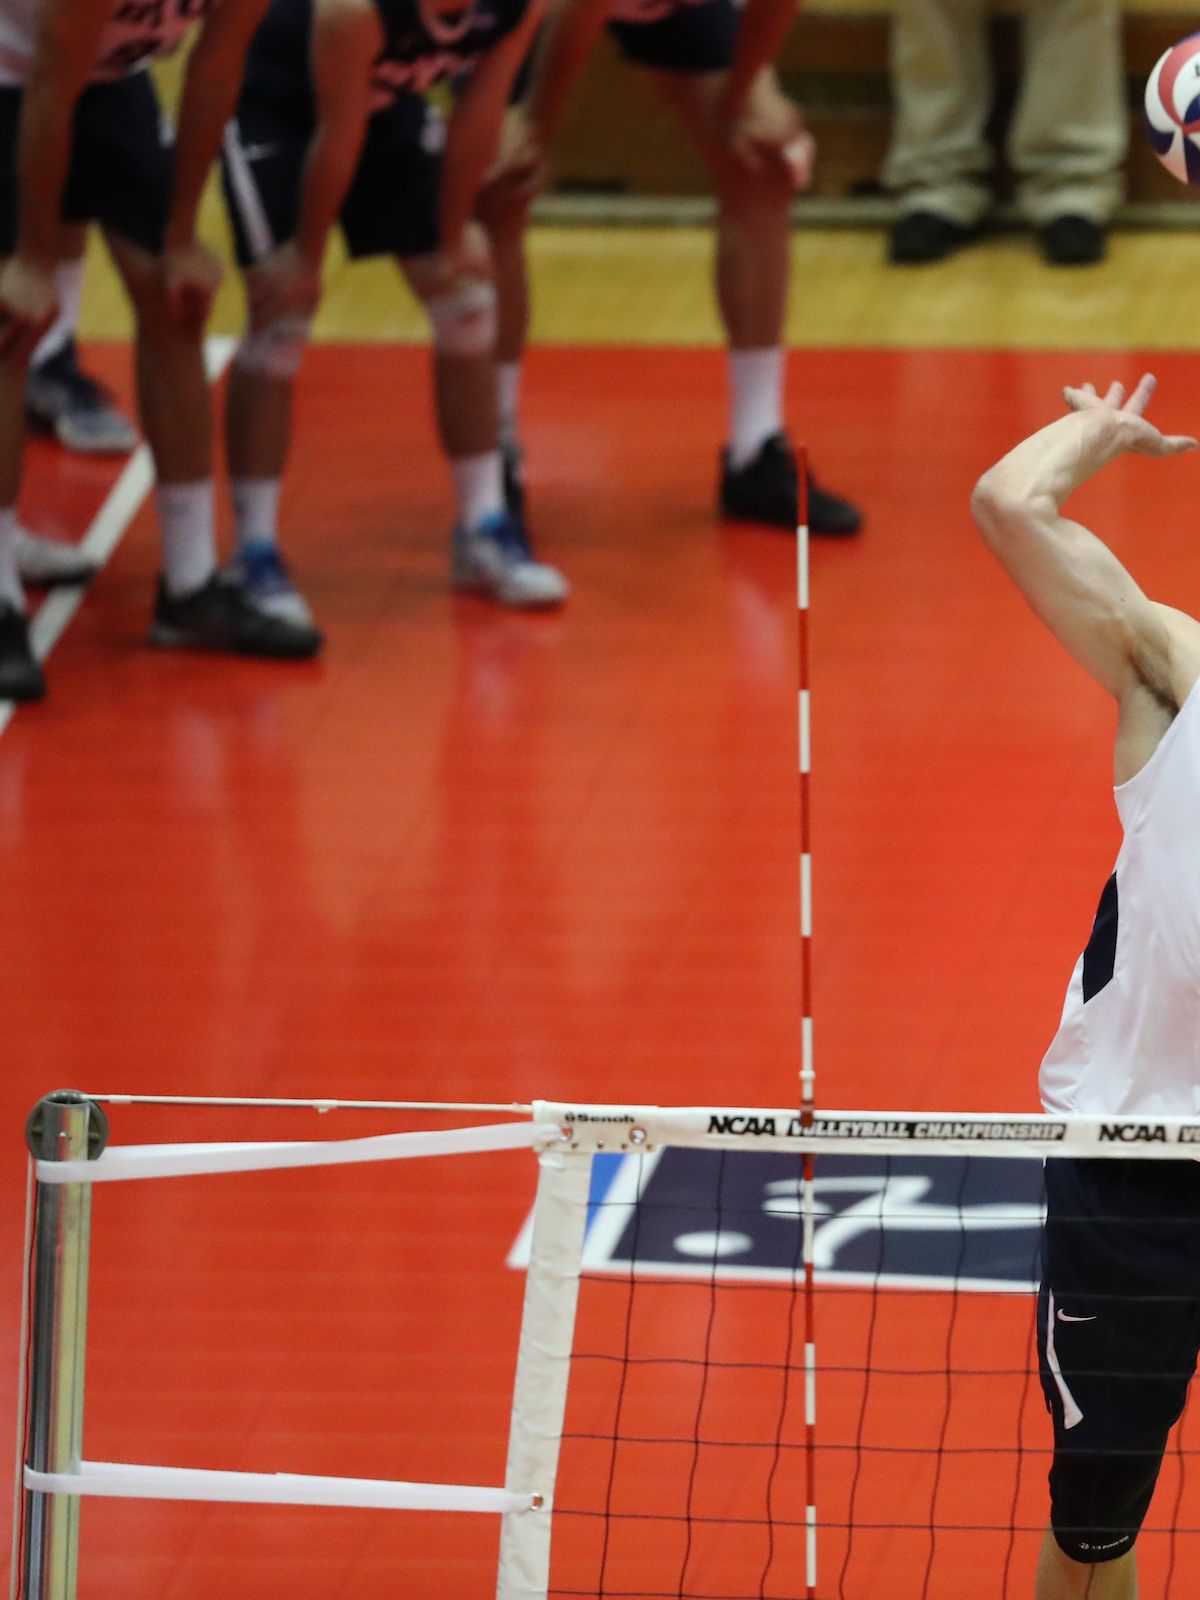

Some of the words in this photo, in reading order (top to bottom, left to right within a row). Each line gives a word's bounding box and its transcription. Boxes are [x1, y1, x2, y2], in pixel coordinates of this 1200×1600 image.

[707, 1115, 777, 1136] NCAA
[914, 1122, 1065, 1140] CHAMPIONSHIP
[1099, 1124, 1168, 1142] NCAA
